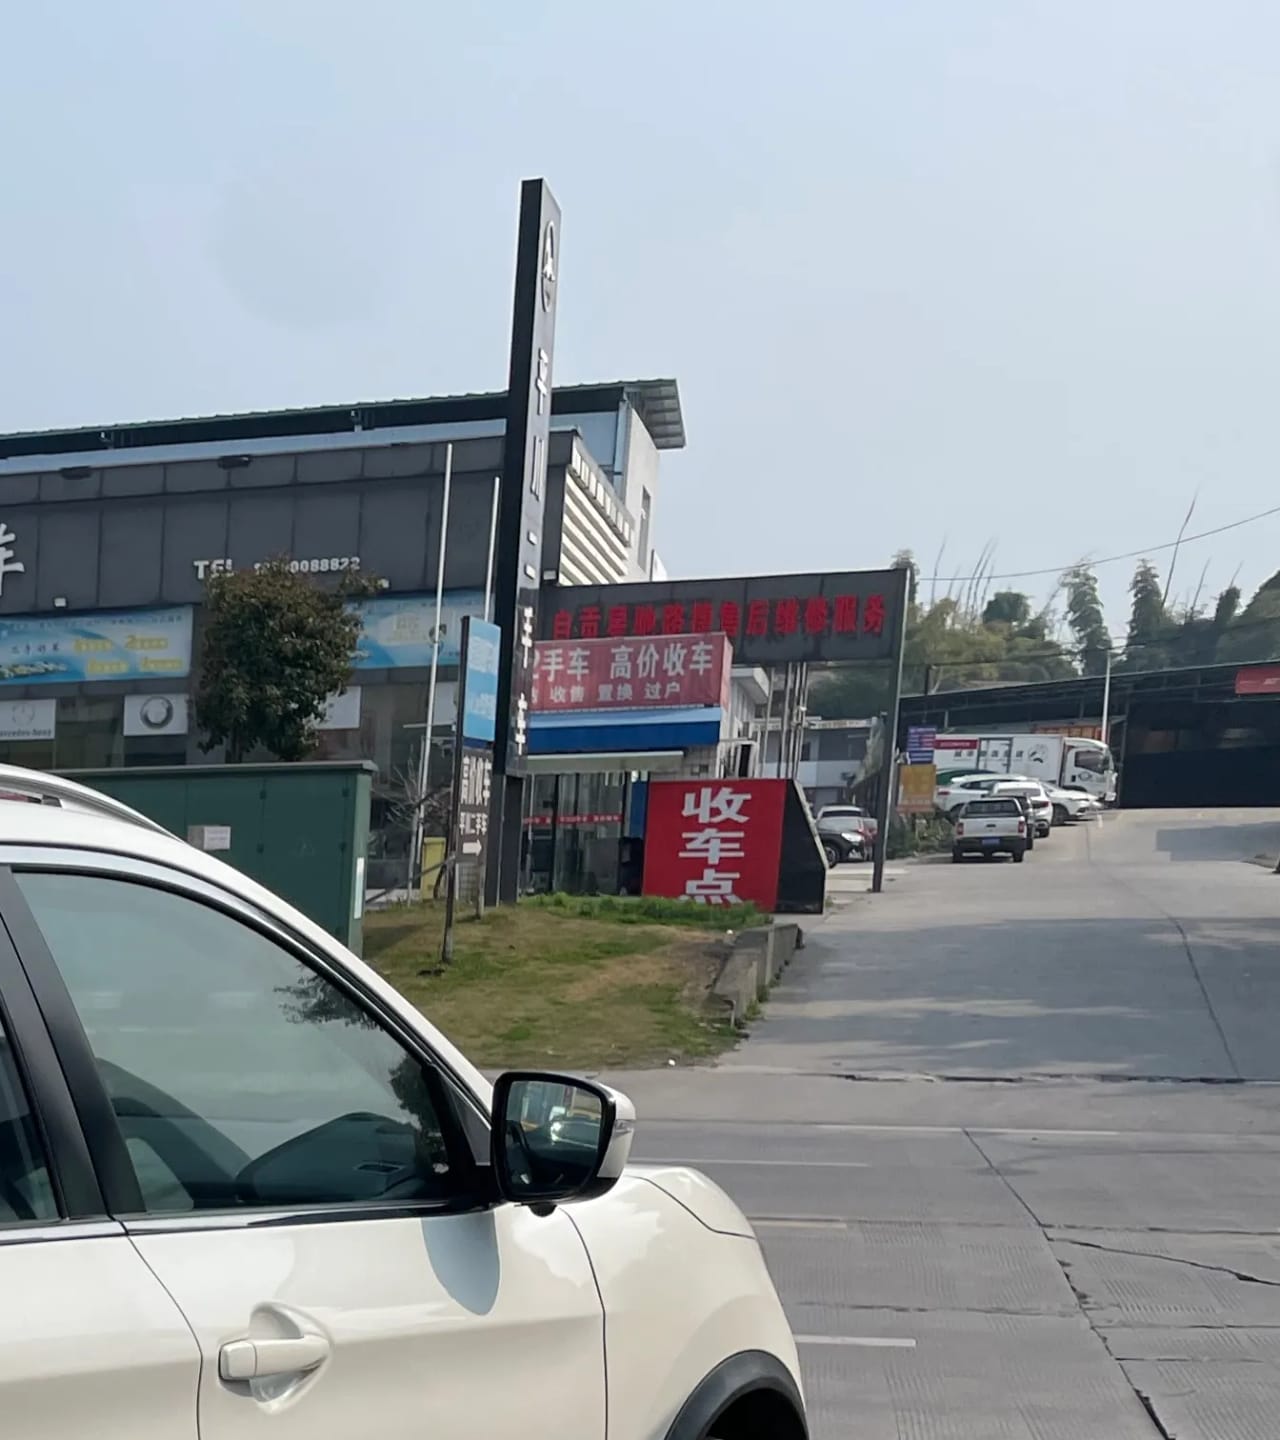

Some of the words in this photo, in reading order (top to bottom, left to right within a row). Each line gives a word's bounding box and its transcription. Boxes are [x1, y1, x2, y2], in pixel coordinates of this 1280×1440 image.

[610, 641, 713, 680] 高价收车
[644, 681, 681, 700] 过户
[677, 787, 752, 904] 收车点
